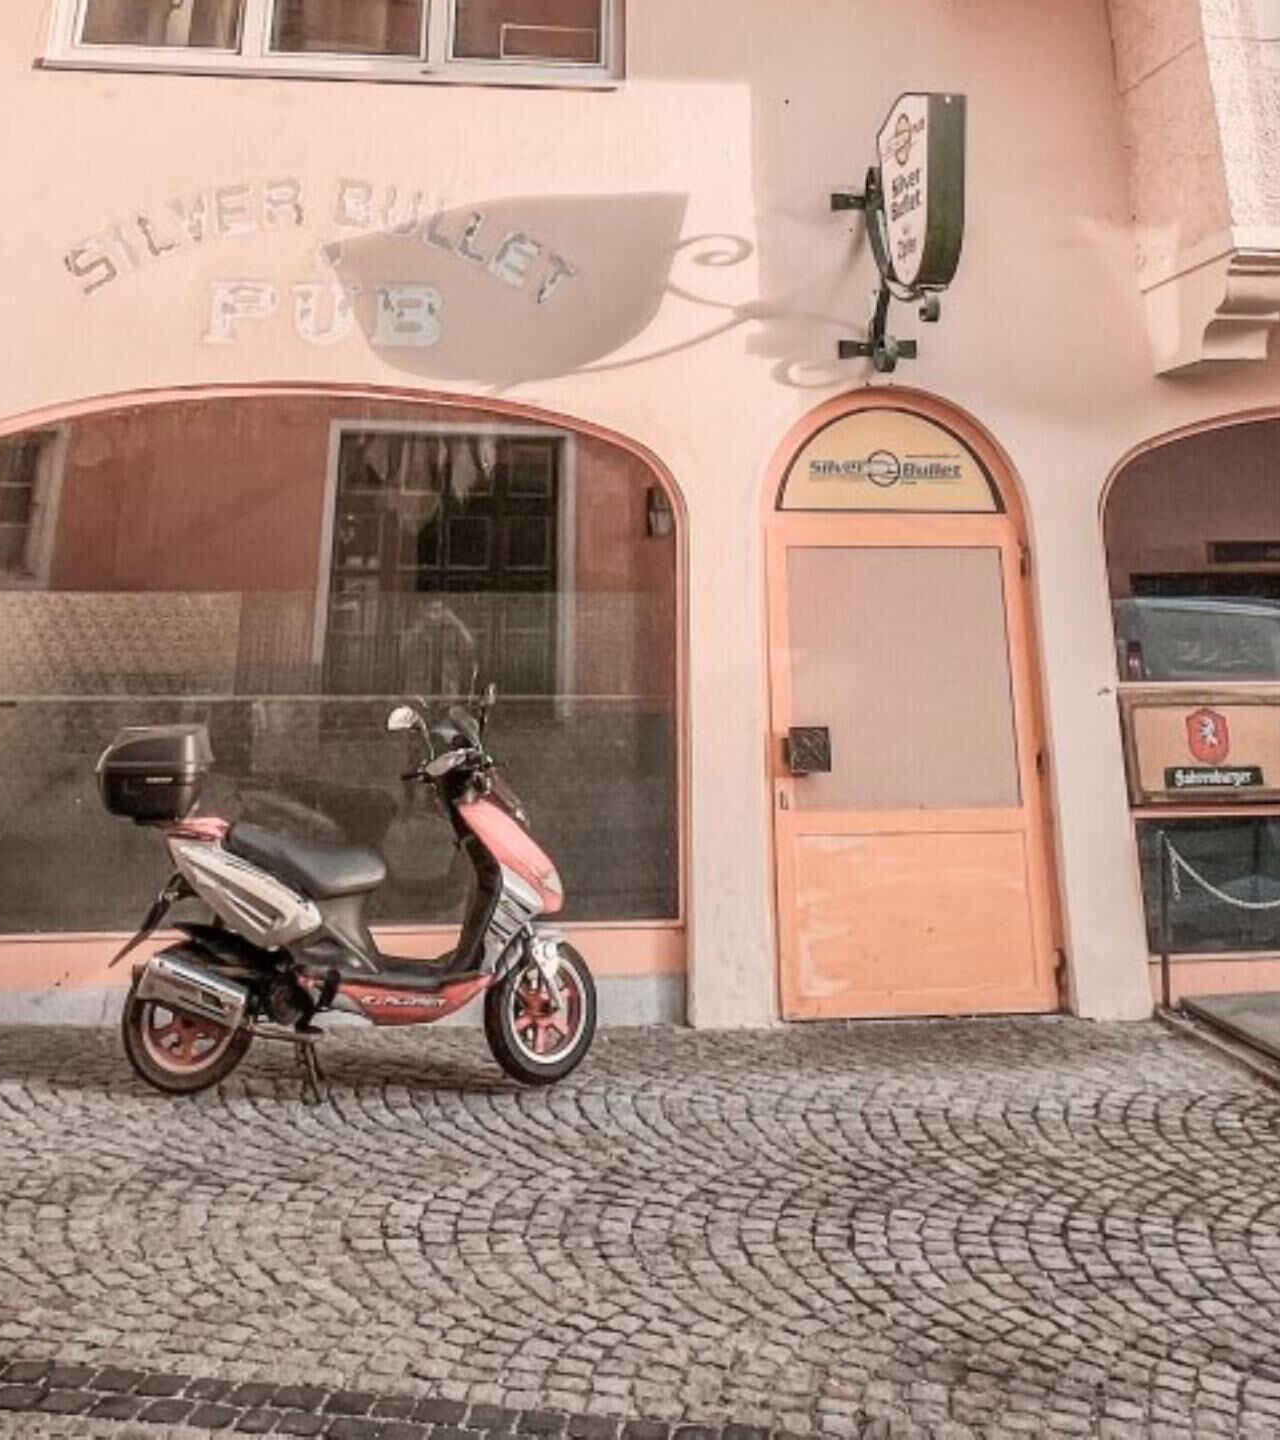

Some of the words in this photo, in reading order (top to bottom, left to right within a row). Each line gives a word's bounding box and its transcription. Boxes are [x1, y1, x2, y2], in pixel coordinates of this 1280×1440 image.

[64, 176, 304, 296] SILVER
[334, 177, 576, 304] BULLET
[200, 279, 443, 348] PUB
[809, 459, 864, 476] Silver
[902, 462, 962, 479] Bullet
